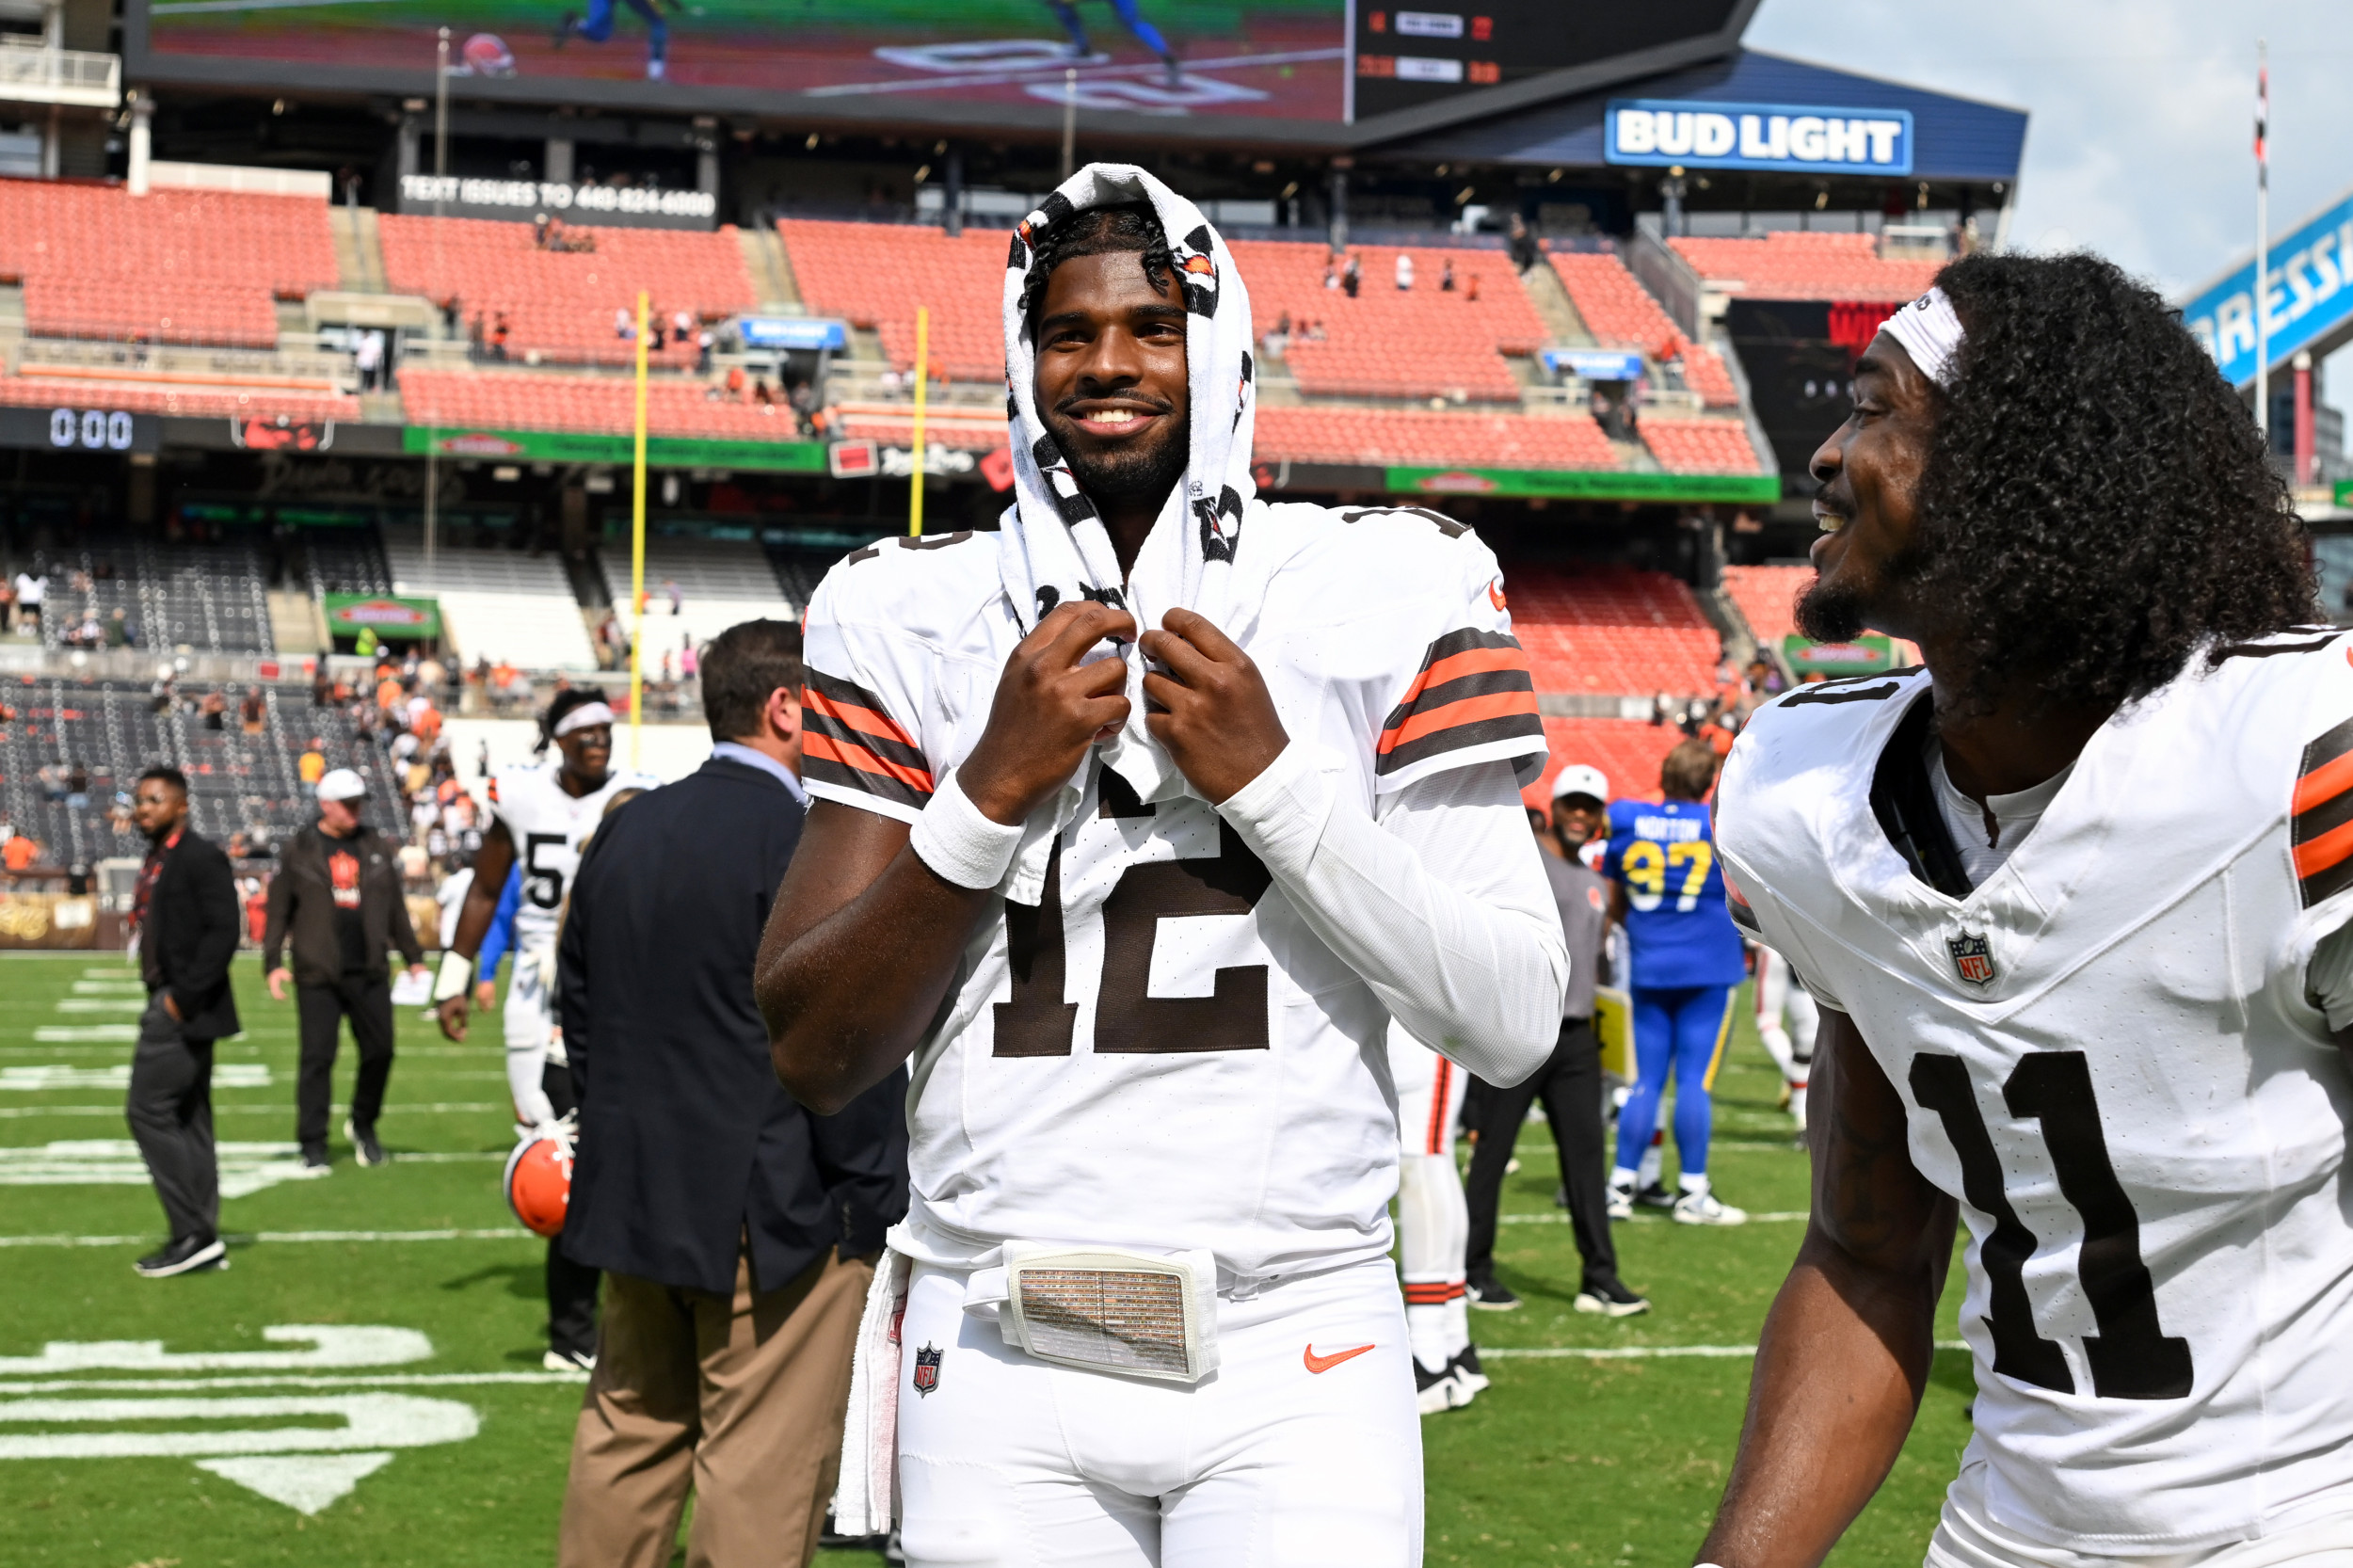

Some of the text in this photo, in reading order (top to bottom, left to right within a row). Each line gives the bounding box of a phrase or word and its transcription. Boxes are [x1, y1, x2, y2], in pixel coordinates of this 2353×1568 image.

[1617, 109, 1901, 164] BUD LIGHT
[539, 183, 573, 209] TO
[527, 832, 584, 909] 5
[1622, 840, 1712, 912] 97
[1959, 956, 1993, 981] NFL
[1908, 1050, 2194, 1400] 11
[916, 1366, 936, 1387] NFL
